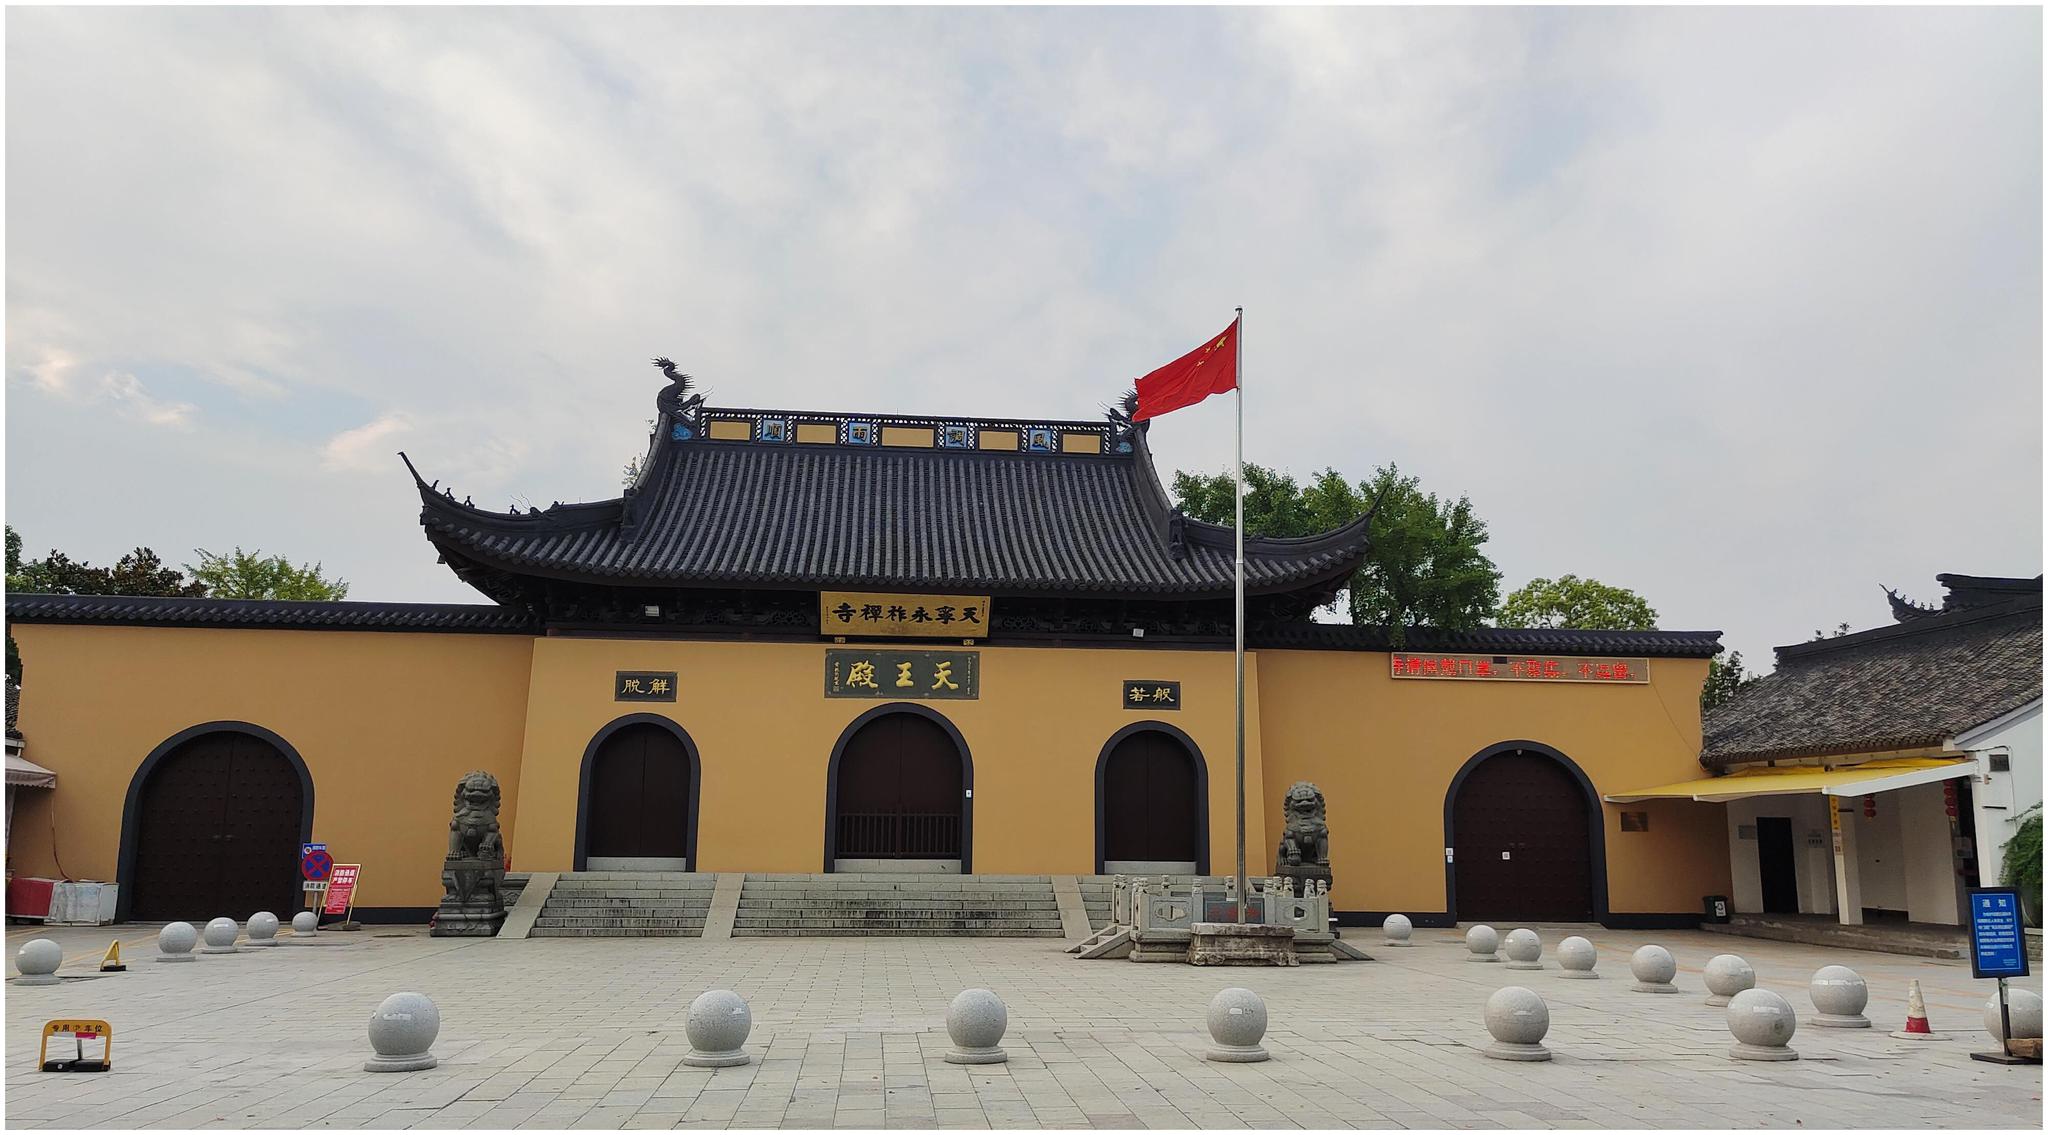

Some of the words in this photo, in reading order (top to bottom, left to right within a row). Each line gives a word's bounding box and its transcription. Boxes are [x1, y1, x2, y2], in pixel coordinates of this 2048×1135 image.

[831, 602, 981, 625] 天寧永祚禪寺
[845, 659, 960, 691] 天王殿
[1129, 686, 1175, 702] 般若
[1982, 898, 2007, 908] 通知
